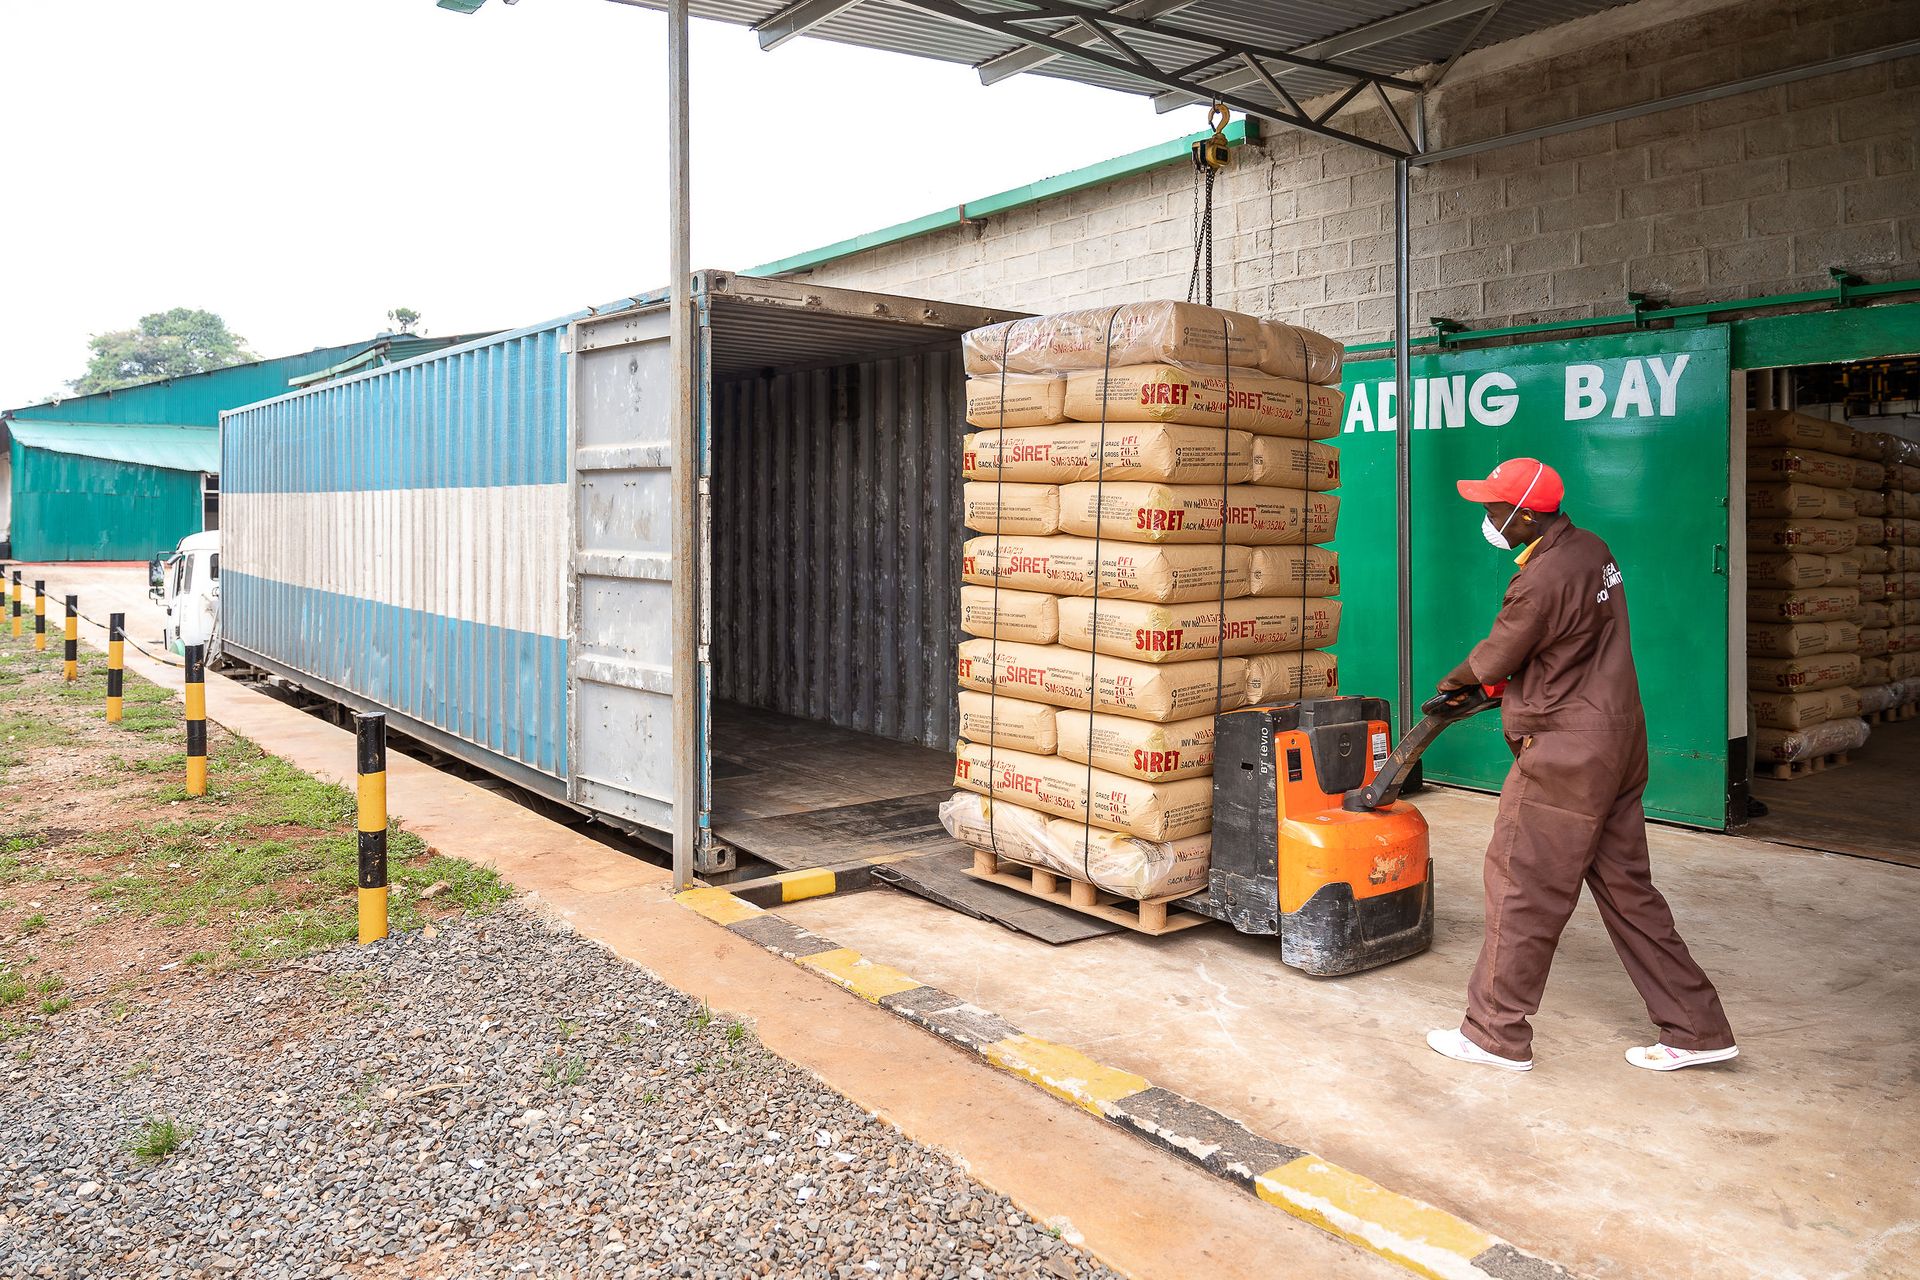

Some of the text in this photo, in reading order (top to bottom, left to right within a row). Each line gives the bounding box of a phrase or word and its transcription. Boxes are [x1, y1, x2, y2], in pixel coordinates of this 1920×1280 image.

[1141, 383, 1189, 406] SIRET
[1564, 354, 1690, 421] BAY
[1228, 390, 1263, 411] SIRET
[1013, 445, 1052, 463] SIRET
[978, 460, 992, 469] SACK
[1120, 458, 1131, 468] 70
[1136, 507, 1184, 531] SIRET
[1219, 507, 1257, 524] SIRET
[1010, 556, 1049, 574] SIRET
[1117, 579, 1129, 588] 70
[1220, 620, 1257, 640] SIRET
[1135, 628, 1183, 652] SIRET
[1007, 665, 1046, 686] SIRET
[1100, 677, 1115, 686] GRADE
[1776, 671, 1806, 687] SIRET
[1100, 687, 1115, 696] GROSS
[1114, 695, 1126, 705] 70
[1181, 739, 1190, 747] INV
[1134, 749, 1180, 773] SIRET
[1260, 759, 1269, 775] BT
[1003, 771, 1042, 795] SIRET
[1095, 791, 1110, 800] GRADE
[1094, 802, 1110, 812] GROSS
[1110, 813, 1121, 823] 70
